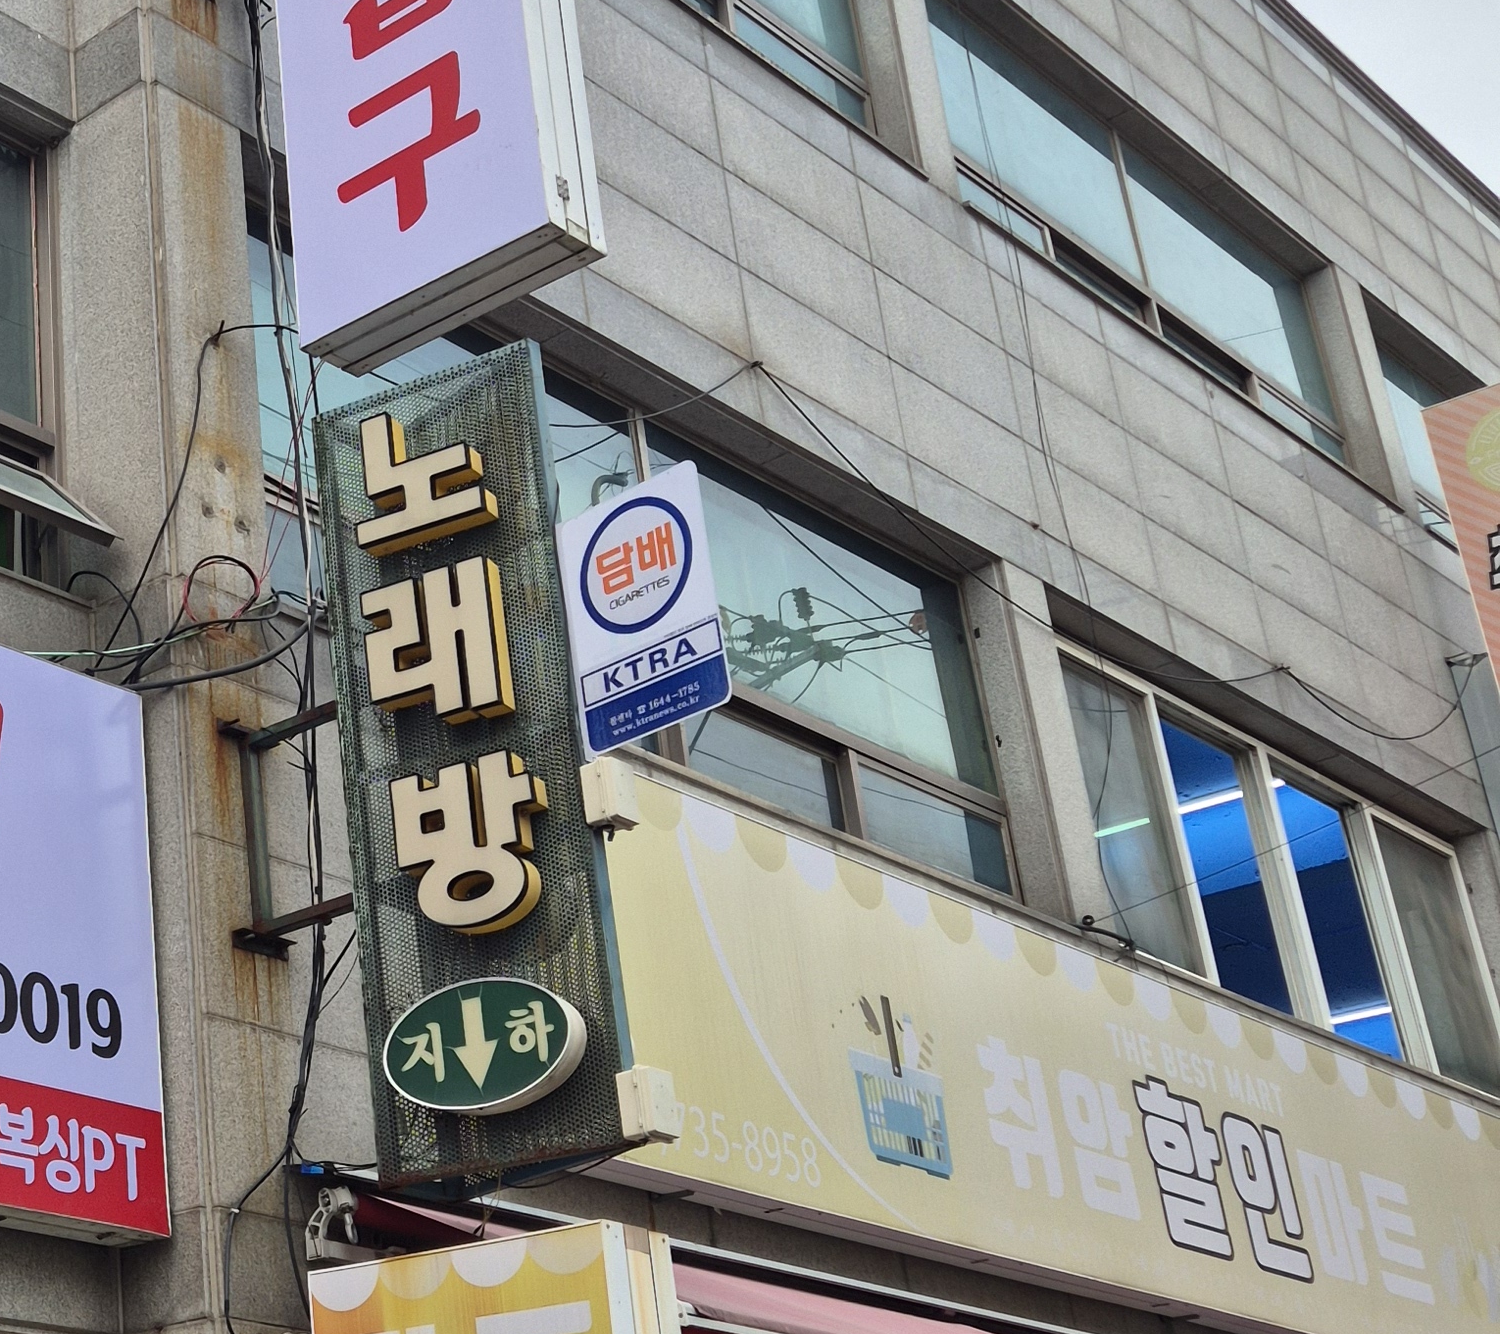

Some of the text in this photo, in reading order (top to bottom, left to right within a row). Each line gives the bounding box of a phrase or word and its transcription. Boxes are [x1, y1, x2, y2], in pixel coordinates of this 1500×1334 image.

[596, 521, 677, 595] 담배
[609, 576, 670, 610] CIGARETTES
[355, 411, 547, 935] 노래방
[603, 637, 698, 693] KTRA
[612, 695, 700, 736] www.ktranews.co.kr
[648, 681, 700, 710] 1644-1785
[1105, 1021, 1284, 1117] THE BEST MART
